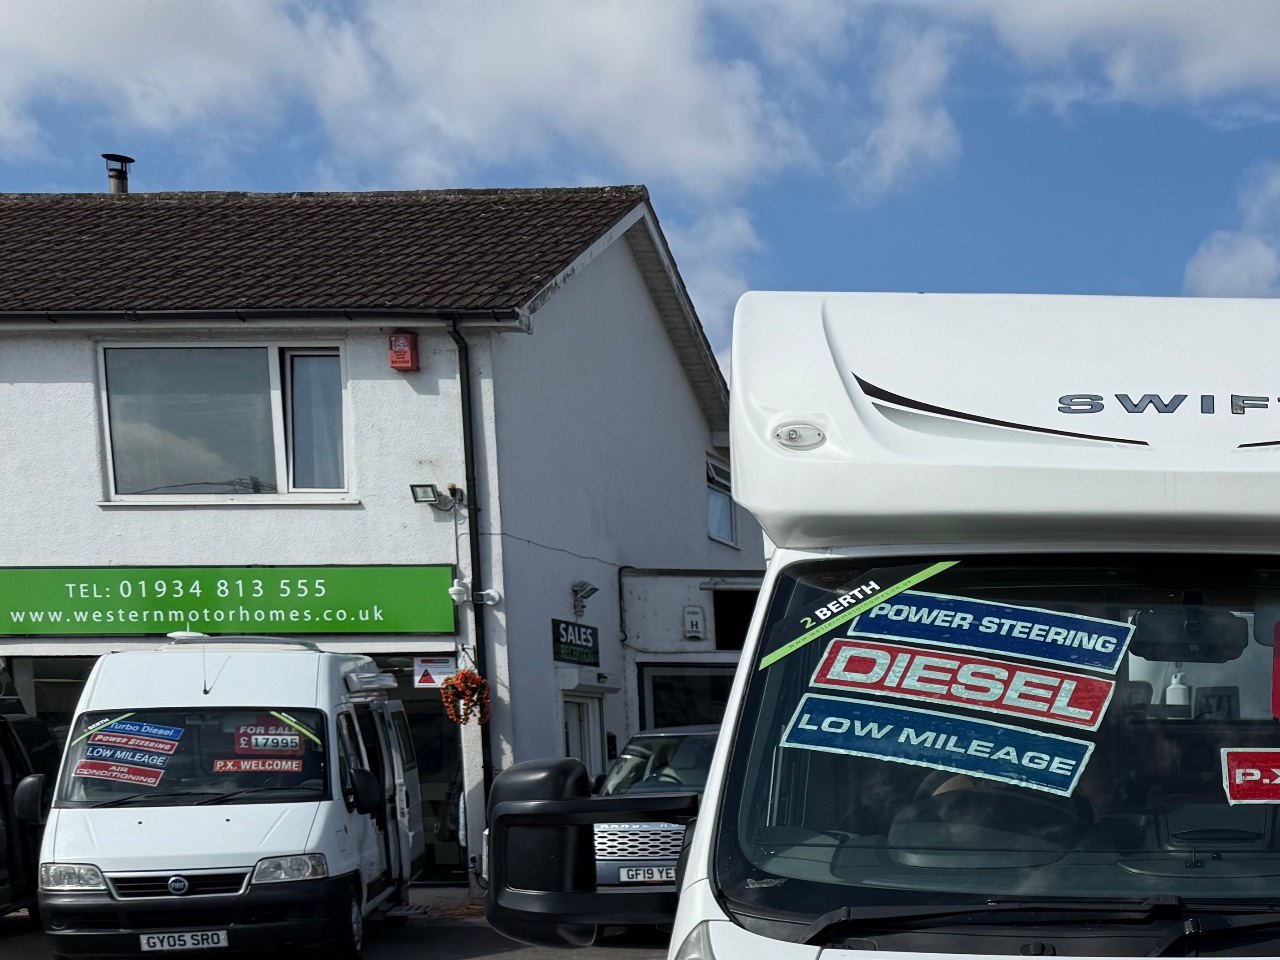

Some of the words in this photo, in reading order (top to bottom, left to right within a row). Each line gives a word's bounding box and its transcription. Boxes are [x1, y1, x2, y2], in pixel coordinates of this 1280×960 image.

[65, 583, 111, 597] TEL:
[119, 580, 202, 597] 01934
[217, 579, 264, 597] 813
[279, 579, 326, 597] 555
[800, 616, 816, 629] 2
[814, 580, 881, 621] BERTH
[10, 605, 384, 622] www.westernmotorhomes.co.uk
[559, 623, 593, 647] SALES
[868, 605, 974, 630] POWER
[978, 617, 1118, 652] STEERING
[560, 645, 595, 663] RECEPTION
[825, 645, 1093, 720] DIESEL
[110, 722, 139, 731] Turbo
[141, 726, 174, 736] Diesel
[239, 726, 265, 734] FOR
[94, 734, 127, 744] POWER
[127, 739, 171, 750] STEERING
[239, 736, 249, 748] £
[253, 737, 298, 748] 17995
[797, 713, 895, 739] LOW
[897, 728, 1077, 776] MILEAGE
[86, 747, 114, 757] LOW
[114, 750, 166, 765] MILEAGE
[109, 765, 129, 773] AIR
[216, 761, 237, 770] P.X.
[241, 760, 300, 770] WELCOME
[76, 768, 157, 783] CONDITIONING
[626, 868, 654, 880] GF19
[657, 867, 676, 879] YE
[146, 934, 187, 948] GY05
[190, 932, 220, 946] SRO
